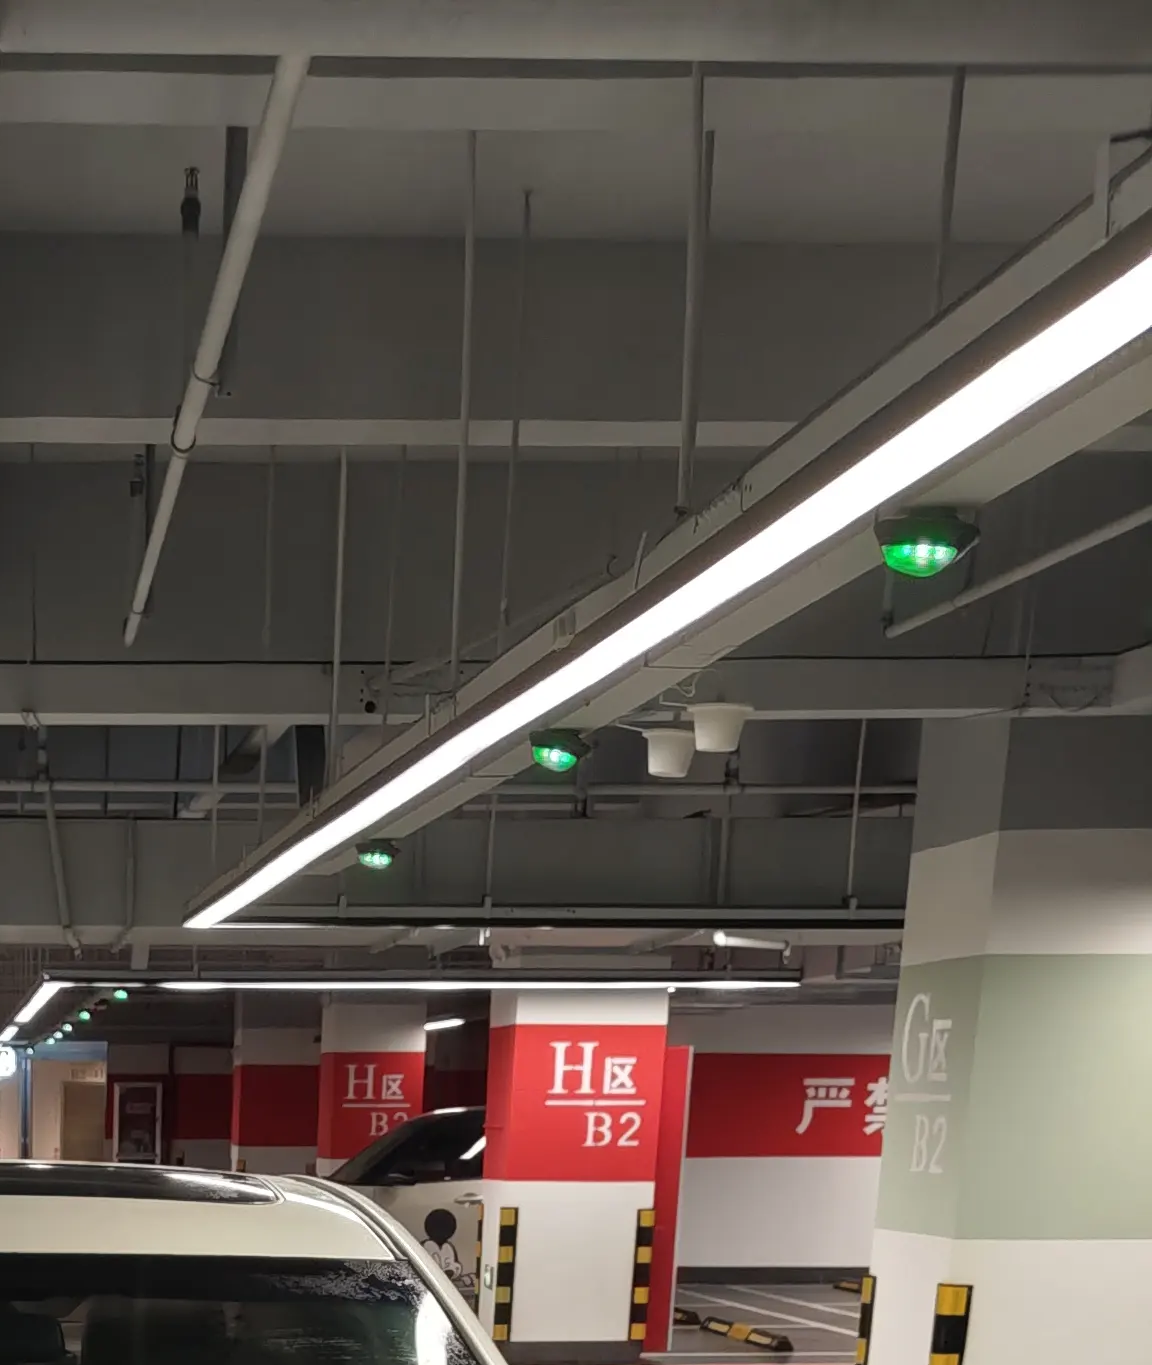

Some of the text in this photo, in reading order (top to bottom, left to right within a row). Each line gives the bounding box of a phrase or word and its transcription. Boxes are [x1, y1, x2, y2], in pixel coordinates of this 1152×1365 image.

[901, 992, 952, 1083] G区
[343, 1063, 405, 1100] H区
[548, 1040, 637, 1095] H区
[582, 1111, 641, 1148] B2
[909, 1114, 947, 1174] B2
